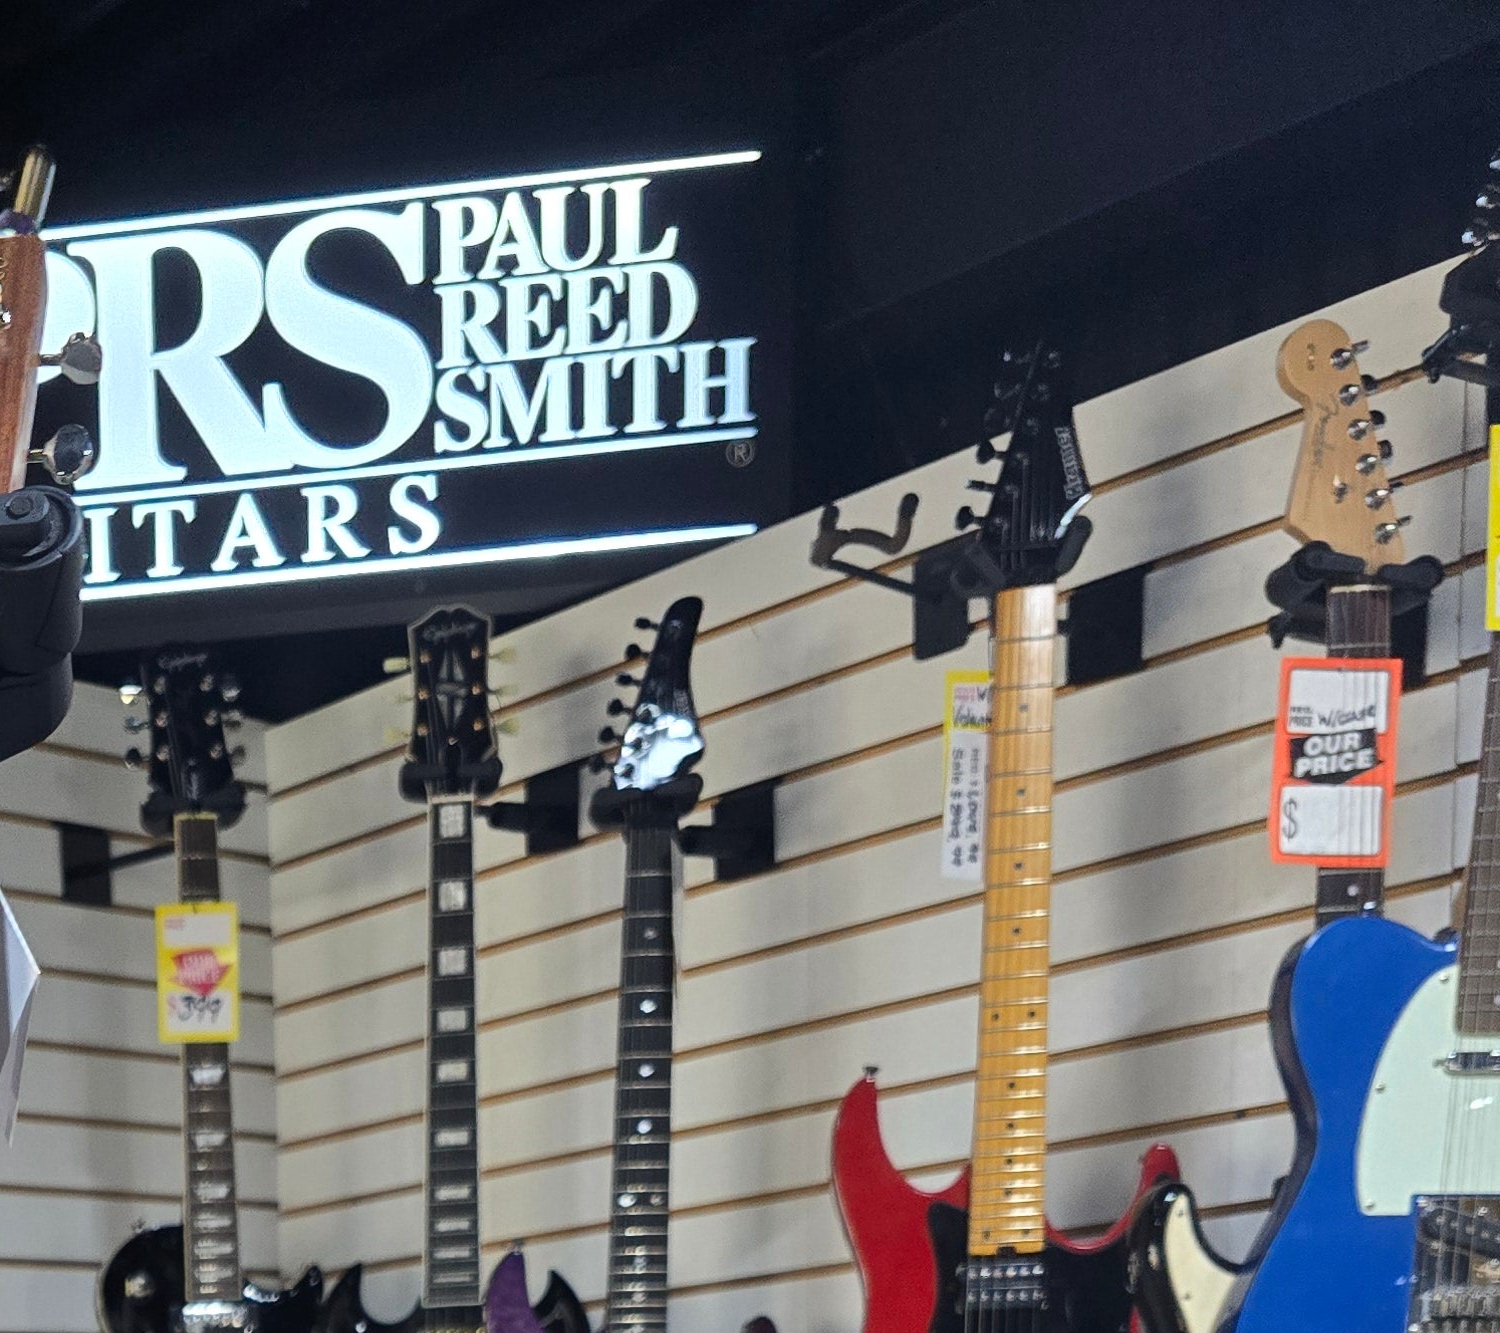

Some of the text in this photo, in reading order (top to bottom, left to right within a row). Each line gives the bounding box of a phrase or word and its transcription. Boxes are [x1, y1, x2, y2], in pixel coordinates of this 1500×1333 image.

[432, 179, 678, 287] PAUL
[432, 261, 699, 371] REED
[432, 336, 759, 455] SMITH
[83, 473, 443, 586] ITARS
[1293, 747, 1375, 779] PRICE
[1303, 732, 1361, 757] OUR
[1283, 798, 1298, 841] $
